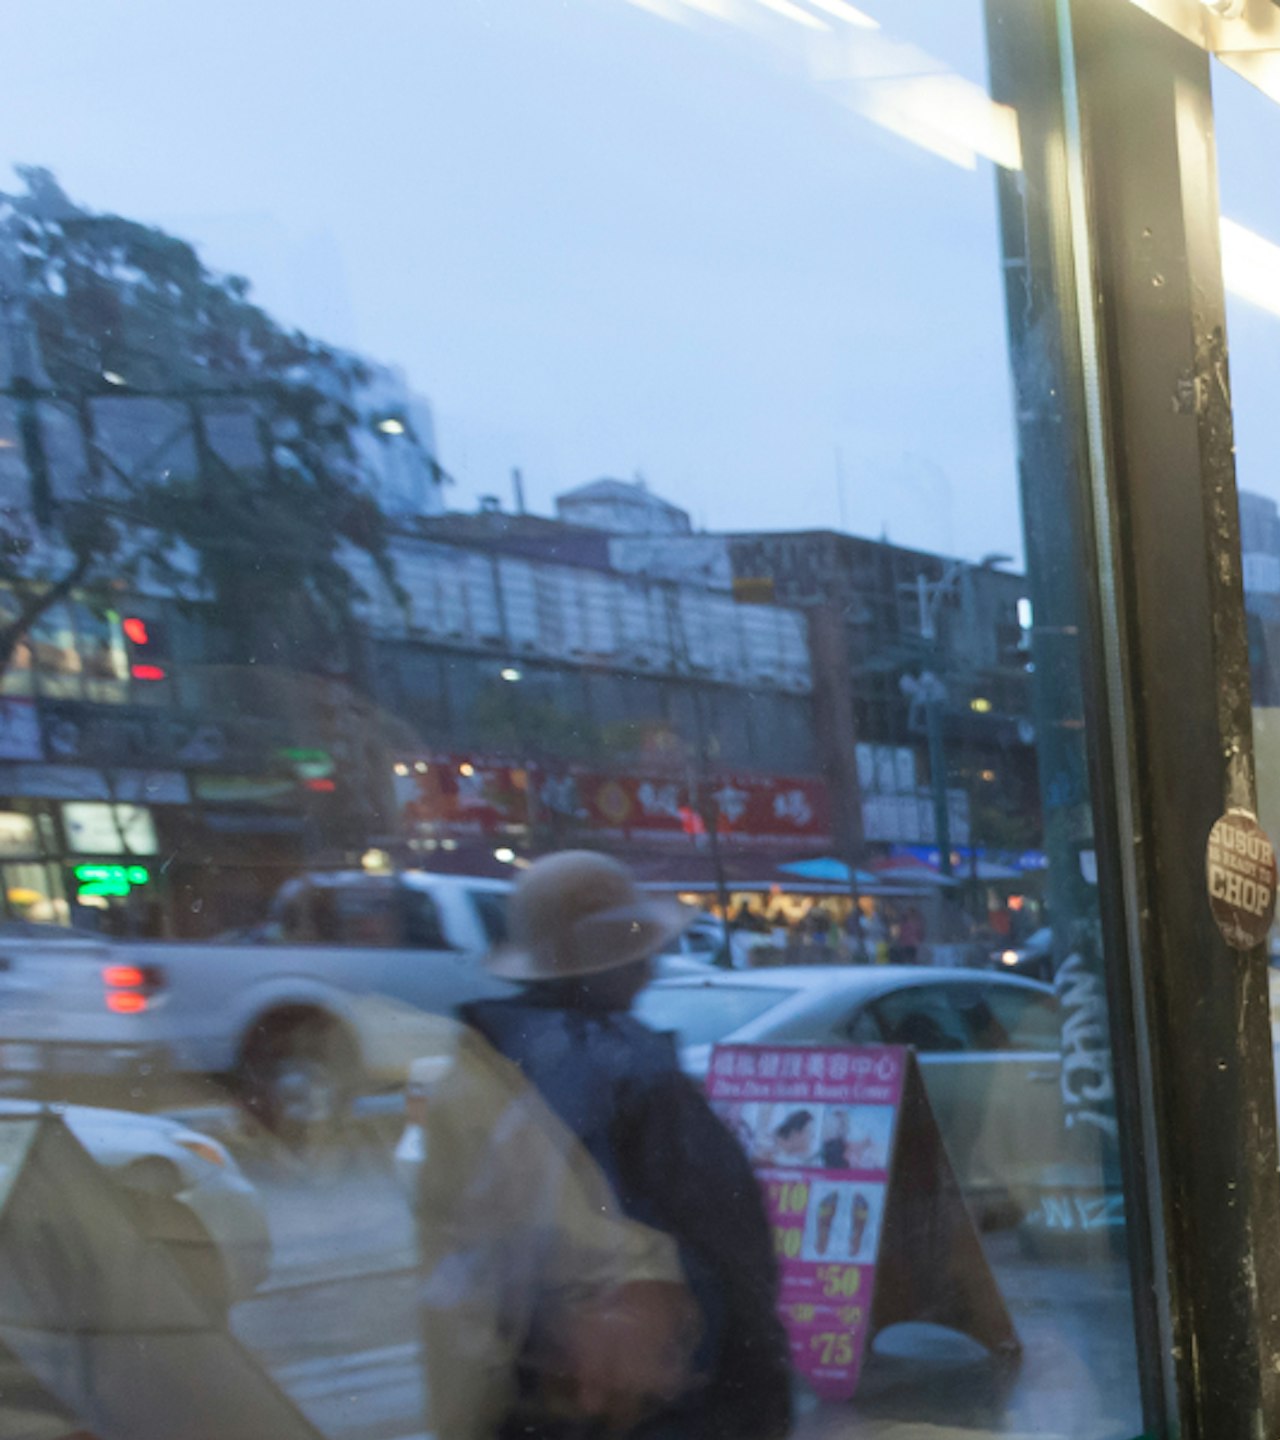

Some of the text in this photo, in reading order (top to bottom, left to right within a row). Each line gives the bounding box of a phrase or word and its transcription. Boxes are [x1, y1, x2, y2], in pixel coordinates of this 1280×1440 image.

[1209, 864, 1271, 917] CHOP
[816, 1265, 861, 1297] $50
[810, 1332, 854, 1365] $75
